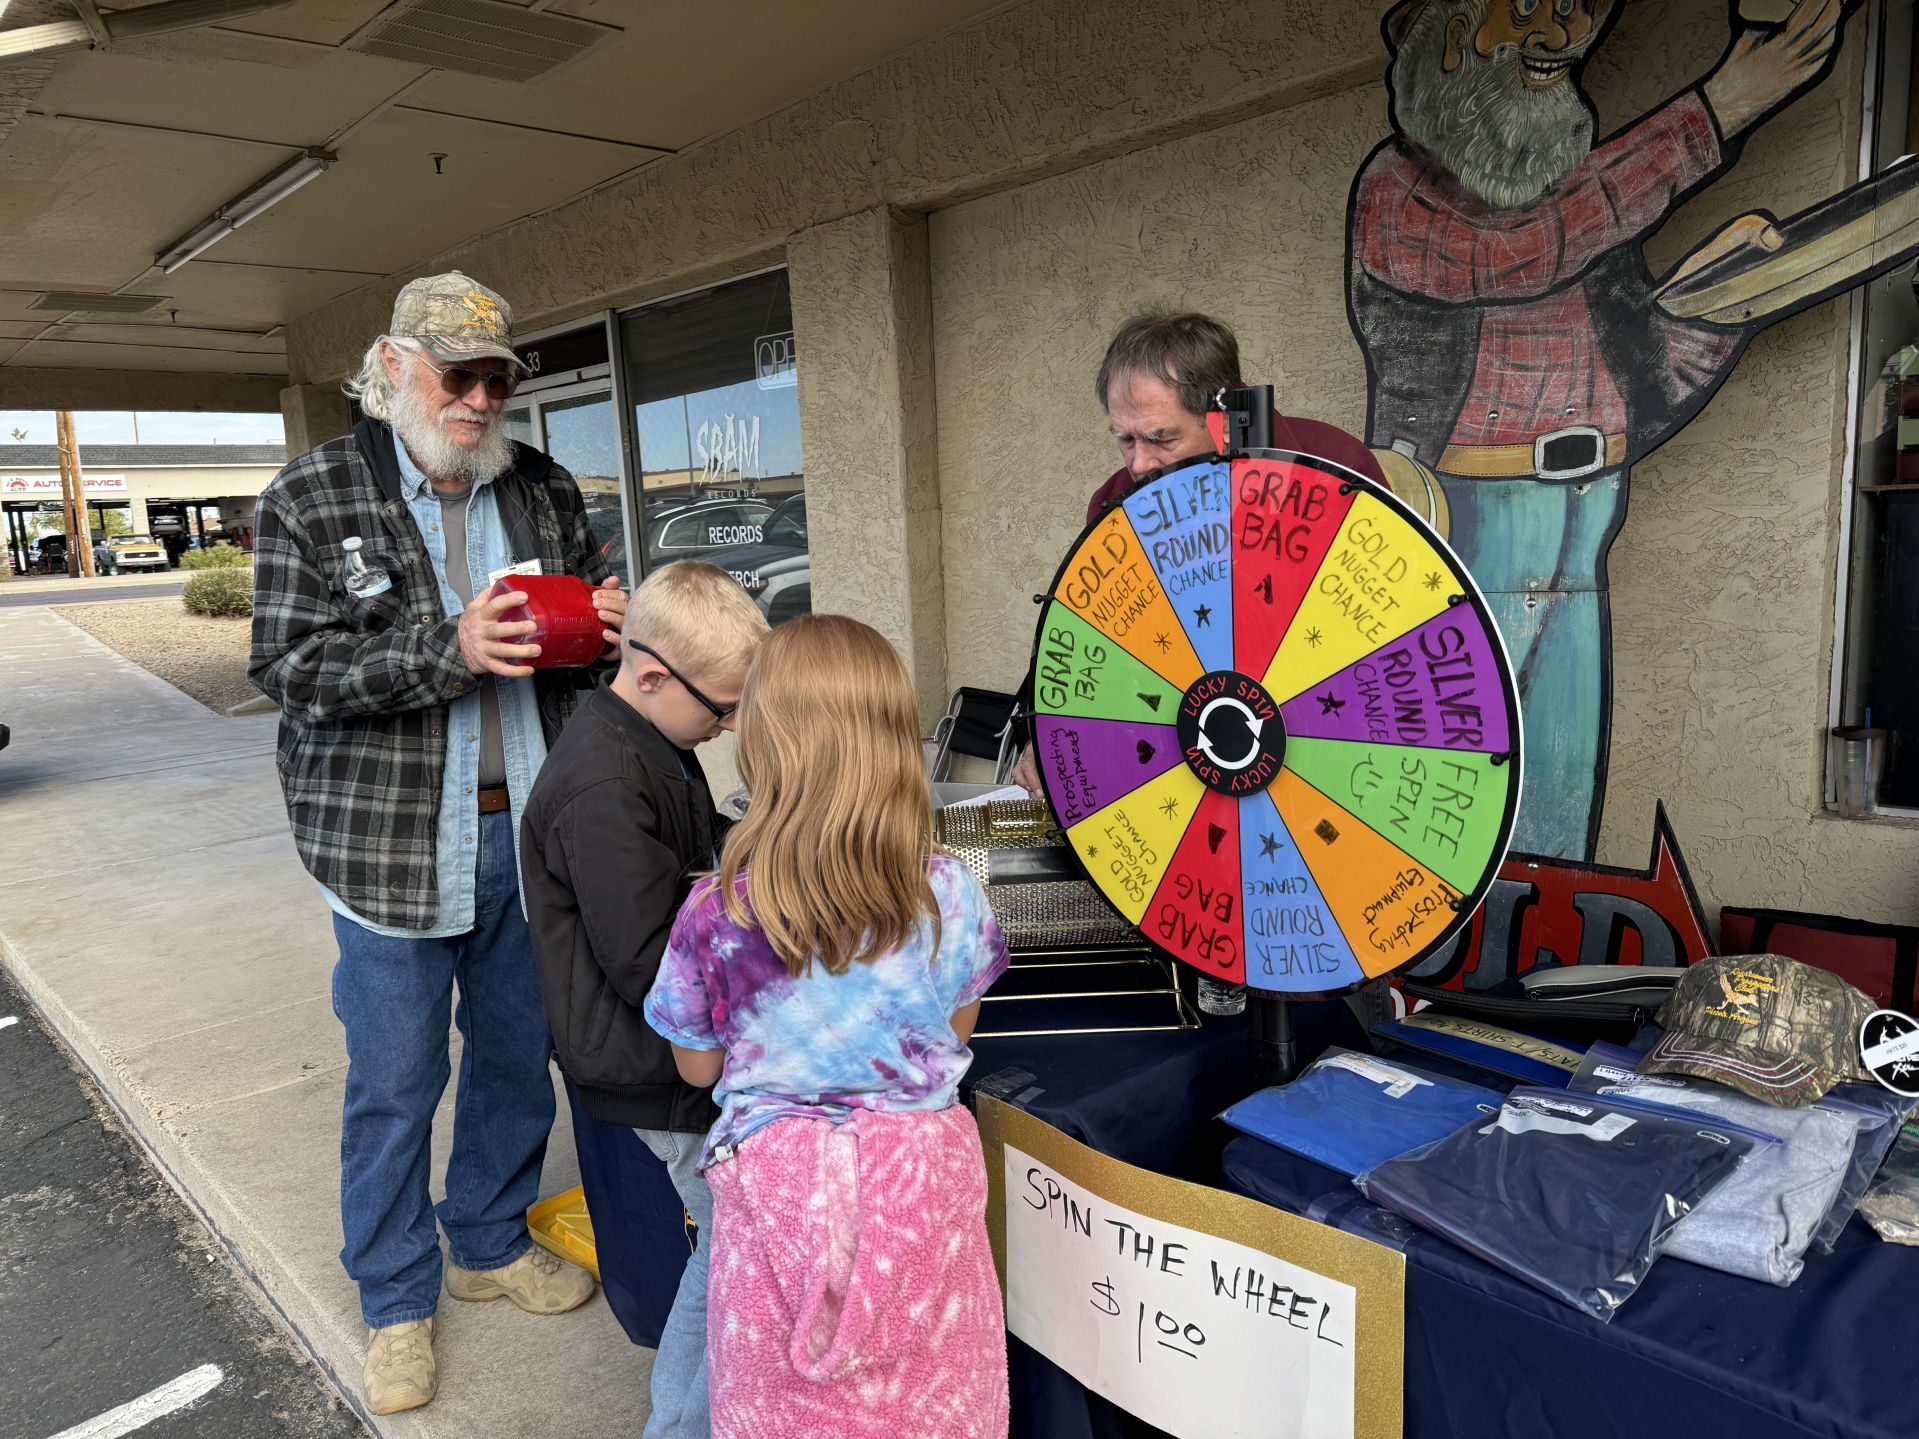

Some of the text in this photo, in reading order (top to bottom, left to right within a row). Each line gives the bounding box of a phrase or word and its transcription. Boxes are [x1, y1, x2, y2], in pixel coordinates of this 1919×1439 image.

[758, 337, 797, 381] OPE
[82, 479, 122, 487] ERVICE
[707, 489, 756, 499] RECORDS
[1137, 471, 1231, 536] SILVER
[1239, 469, 1328, 522] GRAB
[709, 525, 763, 544] RECORDS
[1152, 522, 1230, 574] ROUND
[1240, 512, 1311, 564] BAG
[1347, 518, 1407, 584] GOLD
[728, 570, 760, 588] RCH
[1066, 533, 1128, 610] GOLD
[1092, 562, 1143, 629] NUGGET
[1169, 560, 1228, 595] CHANCE
[1334, 549, 1400, 612] NUGGET
[1113, 579, 1159, 637] CHANCE
[1319, 574, 1386, 645] CHANCE
[1039, 627, 1075, 709] GRAB
[1075, 644, 1107, 701] BAG
[1418, 626, 1484, 747] SILVER
[1184, 676, 1275, 721] LUCKY SPIN
[1353, 663, 1389, 741] CHANCE
[1378, 648, 1428, 745] ROUND
[1186, 746, 1276, 791] LUCKY SPIN
[1389, 756, 1427, 835] SPIN
[1423, 760, 1479, 860] FREE
[1104, 826, 1152, 886] NUGGET
[1110, 860, 1145, 903] GOLD
[1174, 873, 1234, 923] BAG
[1245, 876, 1308, 897] CHANCE
[1158, 904, 1237, 968] GRAB
[1250, 905, 1325, 938] ROUND
[1255, 943, 1341, 976] SILVER
[1886, 1045, 1899, 1055] HATS
[1700, 1131, 1729, 1143] MEDIUM
[1022, 1167, 1345, 1348] SPIN THE WHEEL
